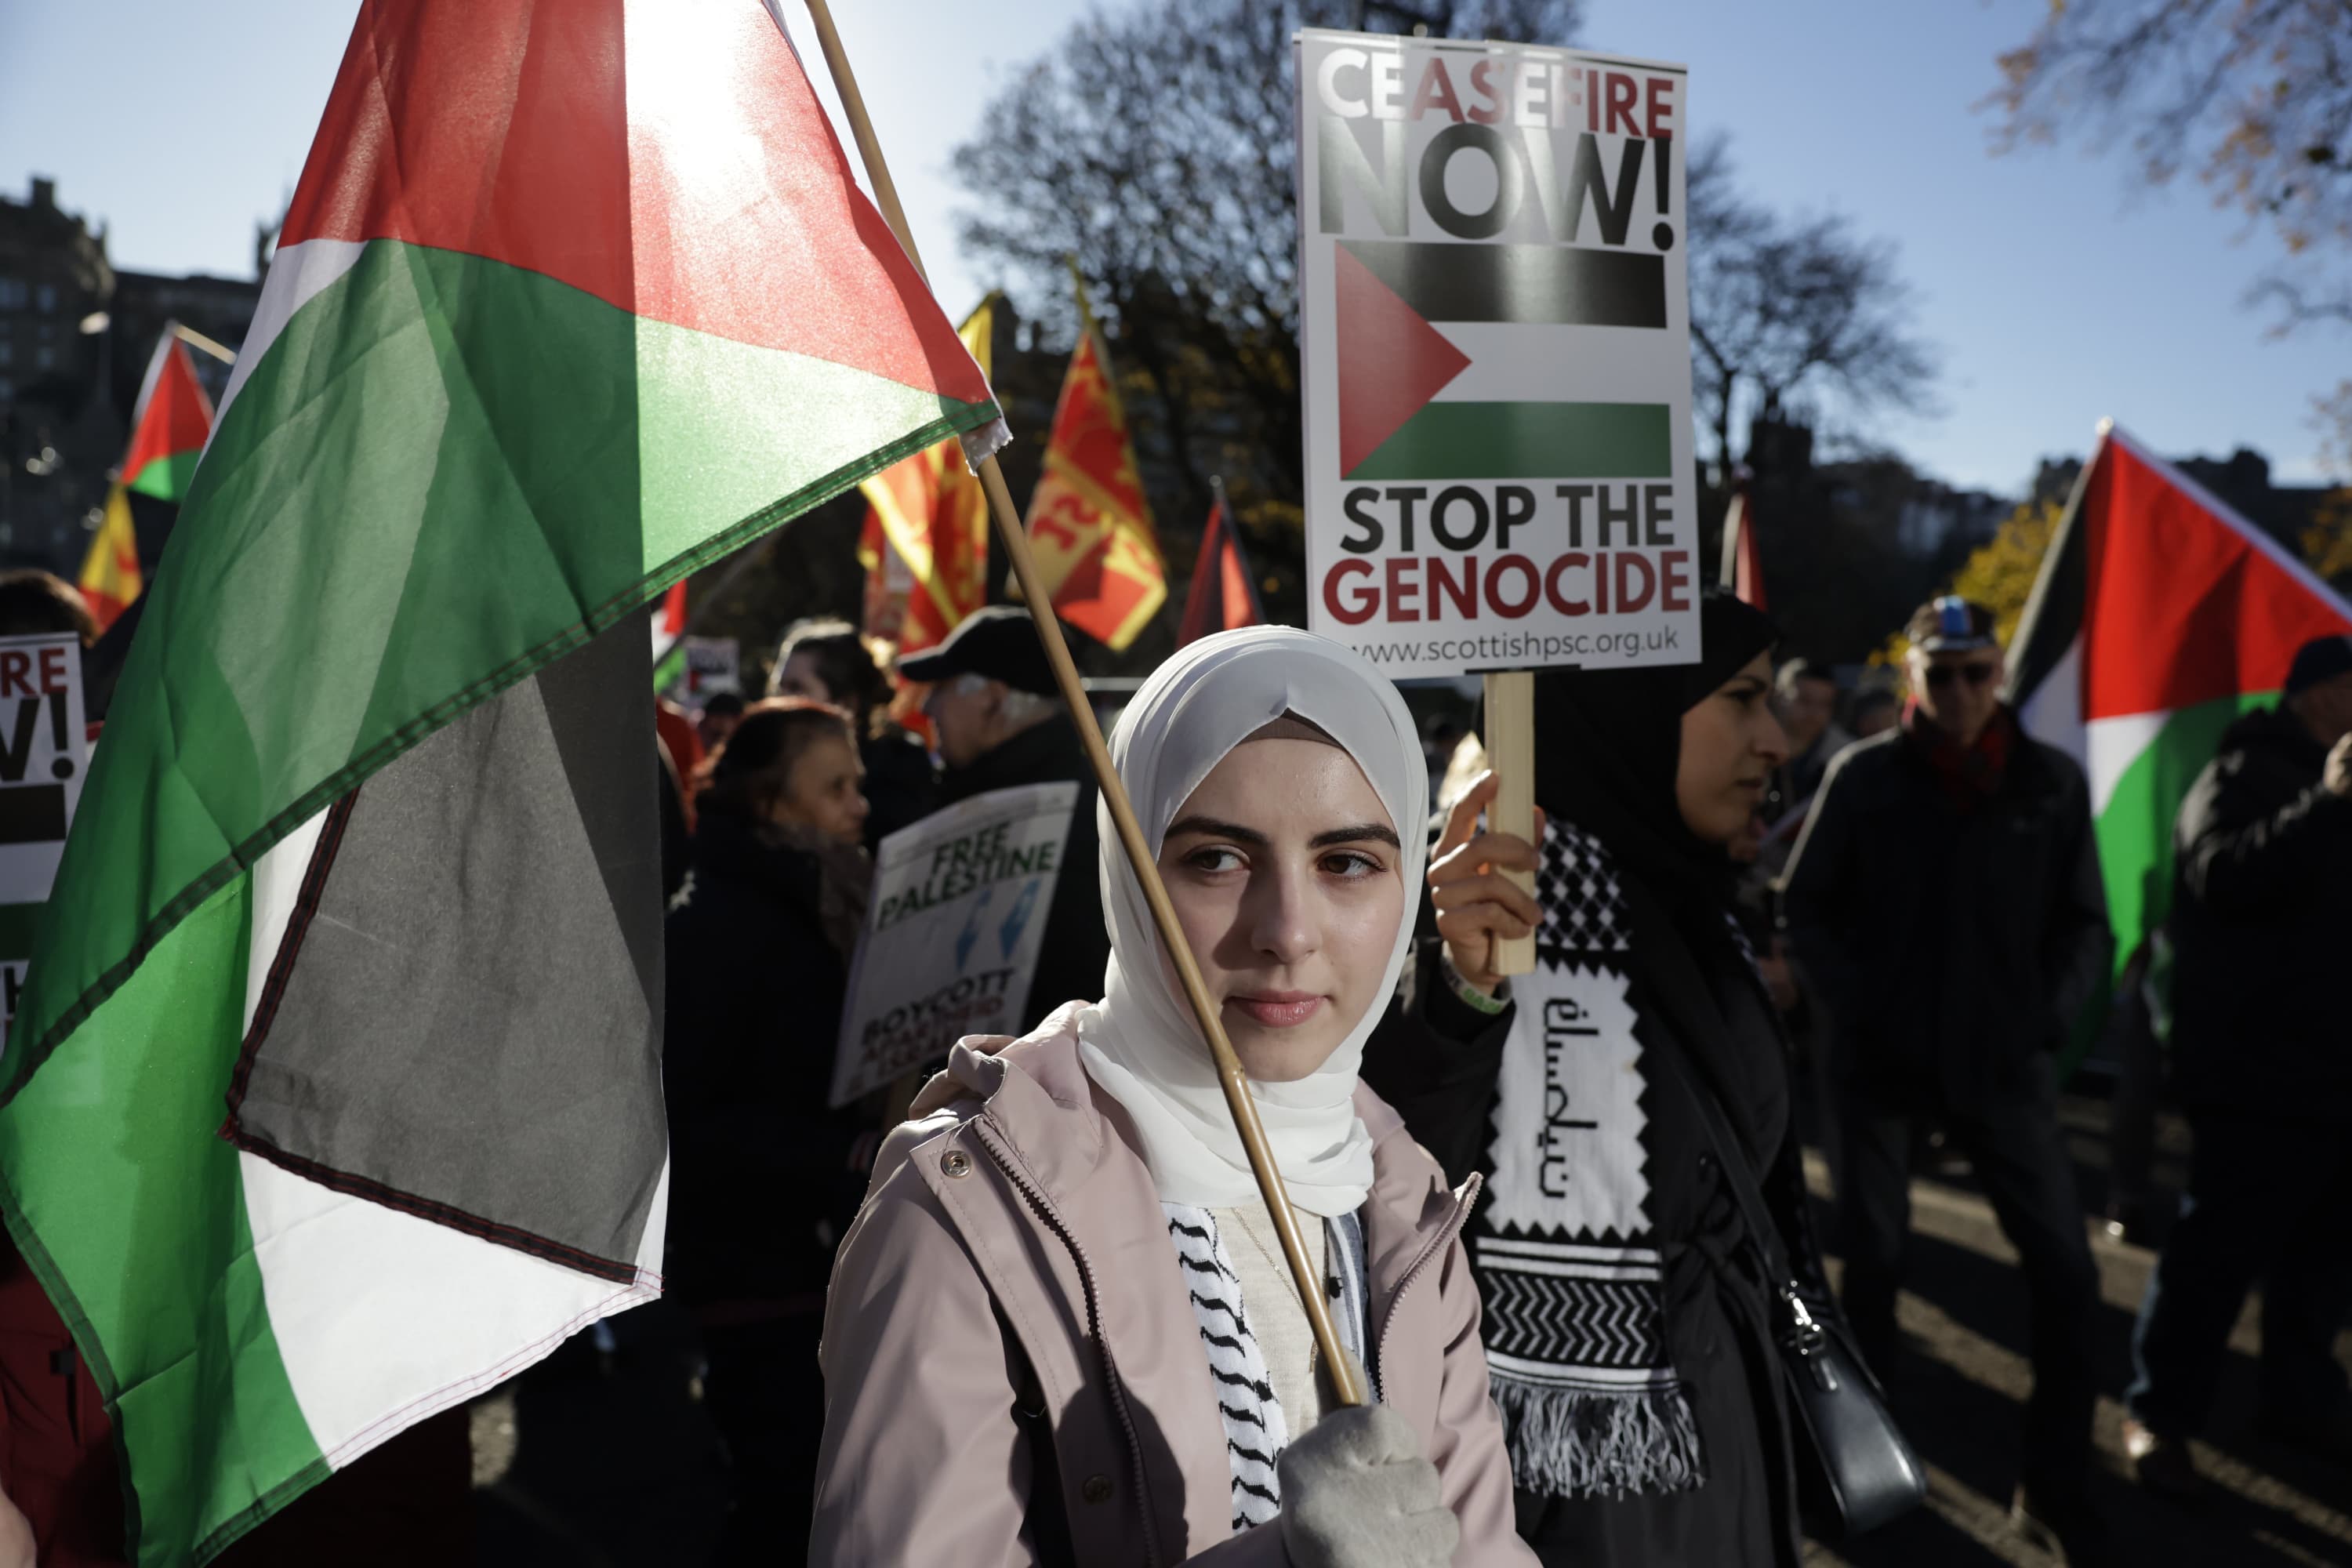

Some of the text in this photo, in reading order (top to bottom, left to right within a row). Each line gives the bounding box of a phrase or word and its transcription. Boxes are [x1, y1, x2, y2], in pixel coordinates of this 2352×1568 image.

[1317, 49, 1673, 138] CEASEFIRE
[1319, 116, 1675, 251] NOW!
[1340, 485, 1674, 554] STOP THE
[1323, 551, 1690, 625] GENOCIDE
[876, 840, 1057, 931] PALESTINE
[932, 821, 1012, 877] FREE
[863, 968, 1014, 1041] BOYCOTT
